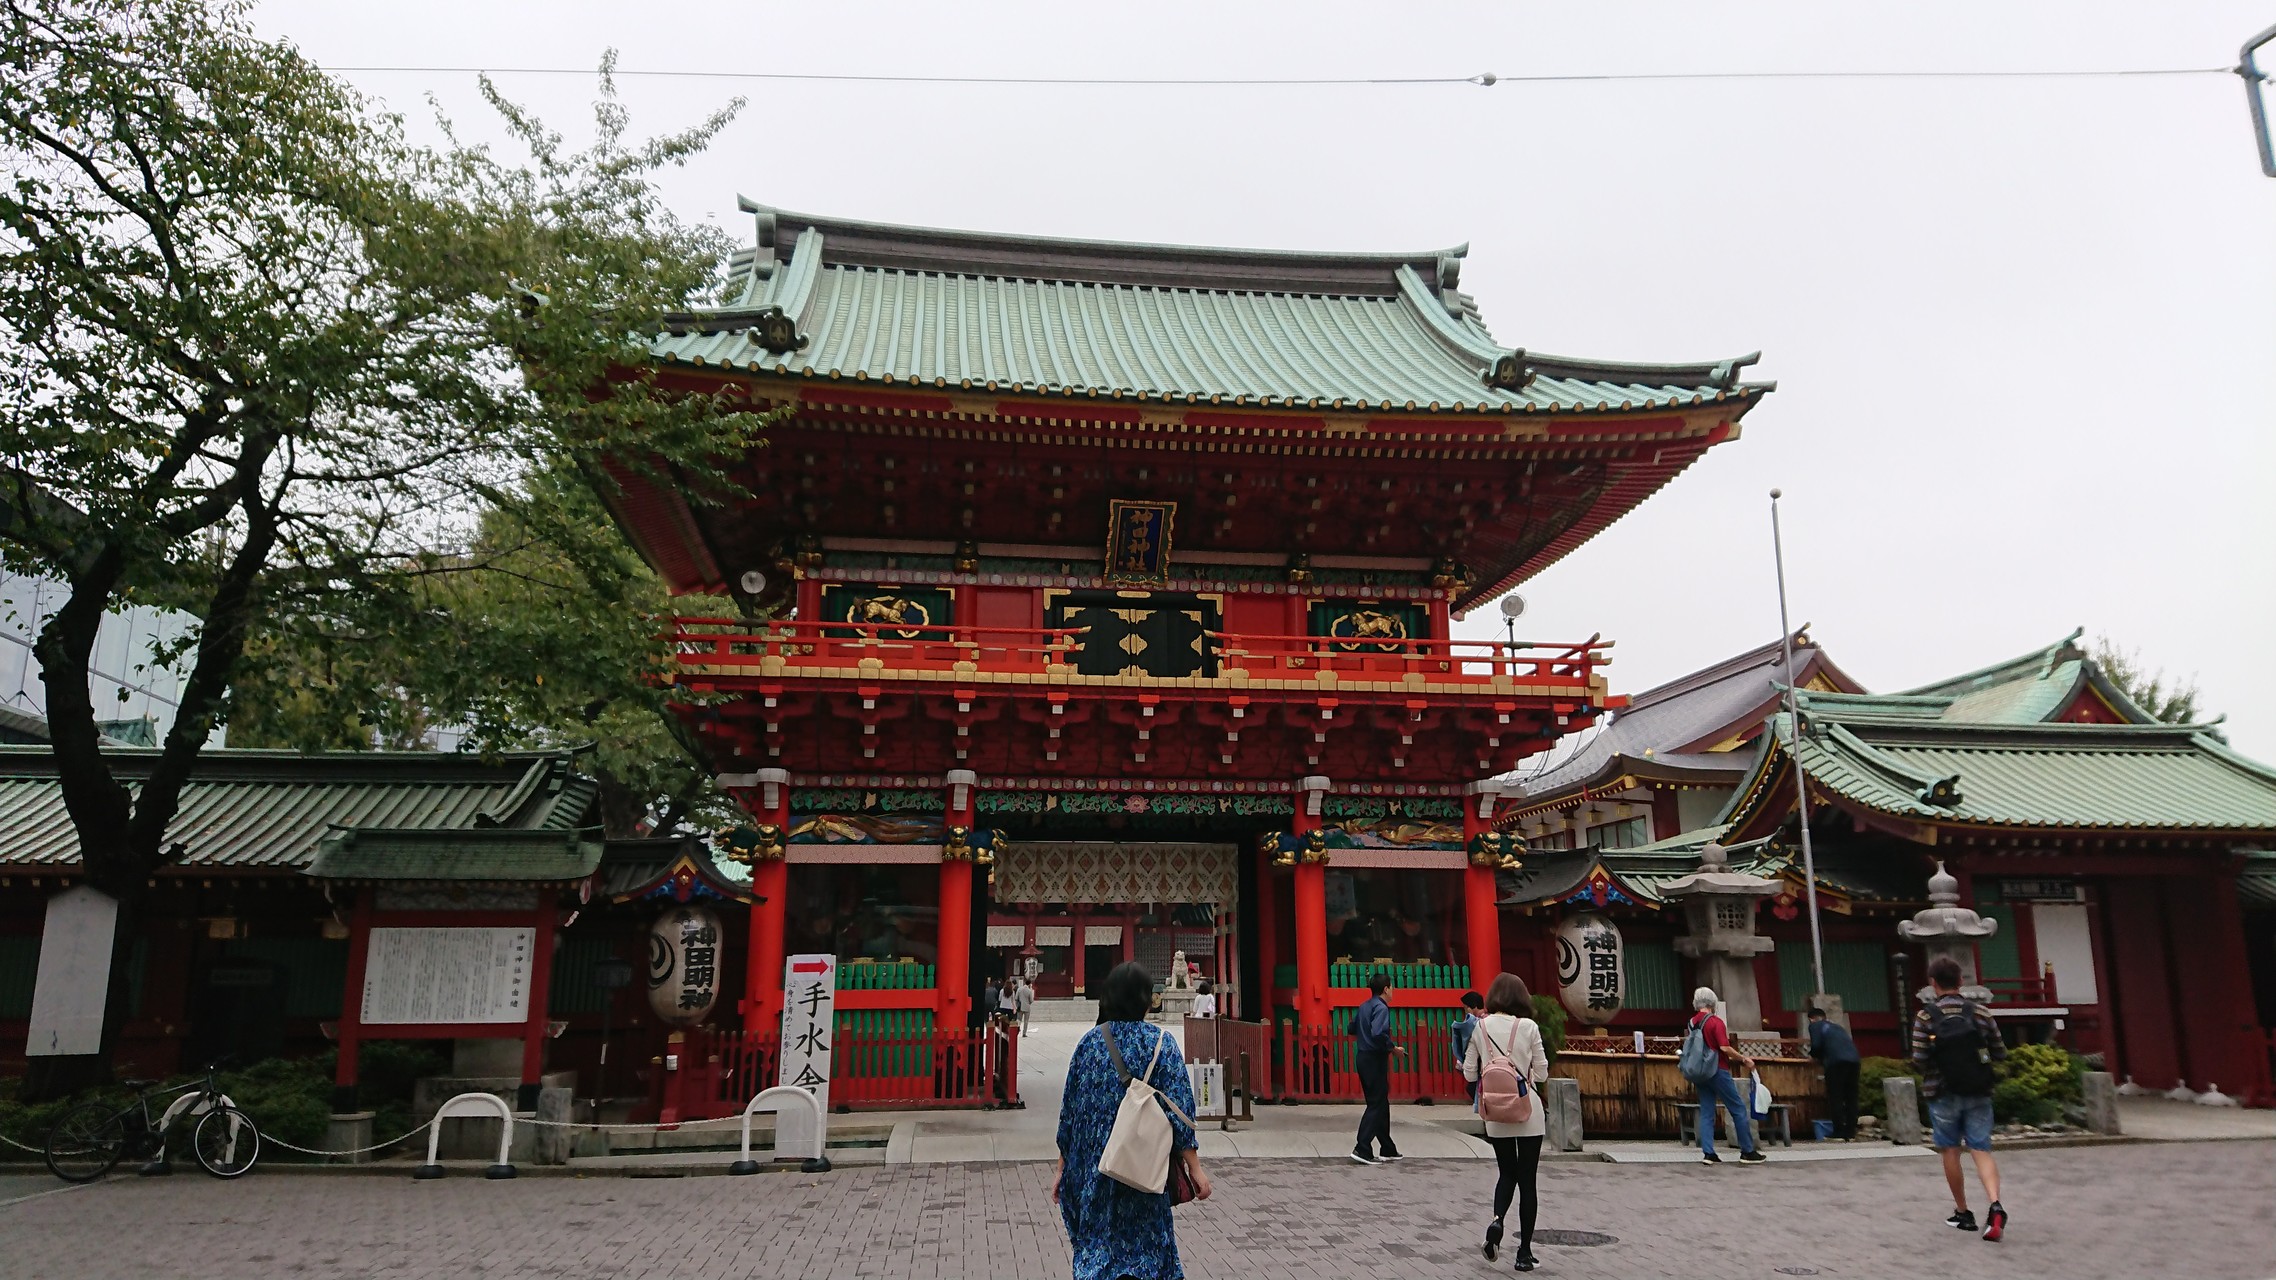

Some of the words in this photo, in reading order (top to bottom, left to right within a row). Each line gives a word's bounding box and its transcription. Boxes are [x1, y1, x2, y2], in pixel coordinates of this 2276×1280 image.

[1127, 509, 1153, 571] 神田神社
[678, 921, 716, 1010] 神田明神
[1583, 931, 1620, 1011] 神田明神
